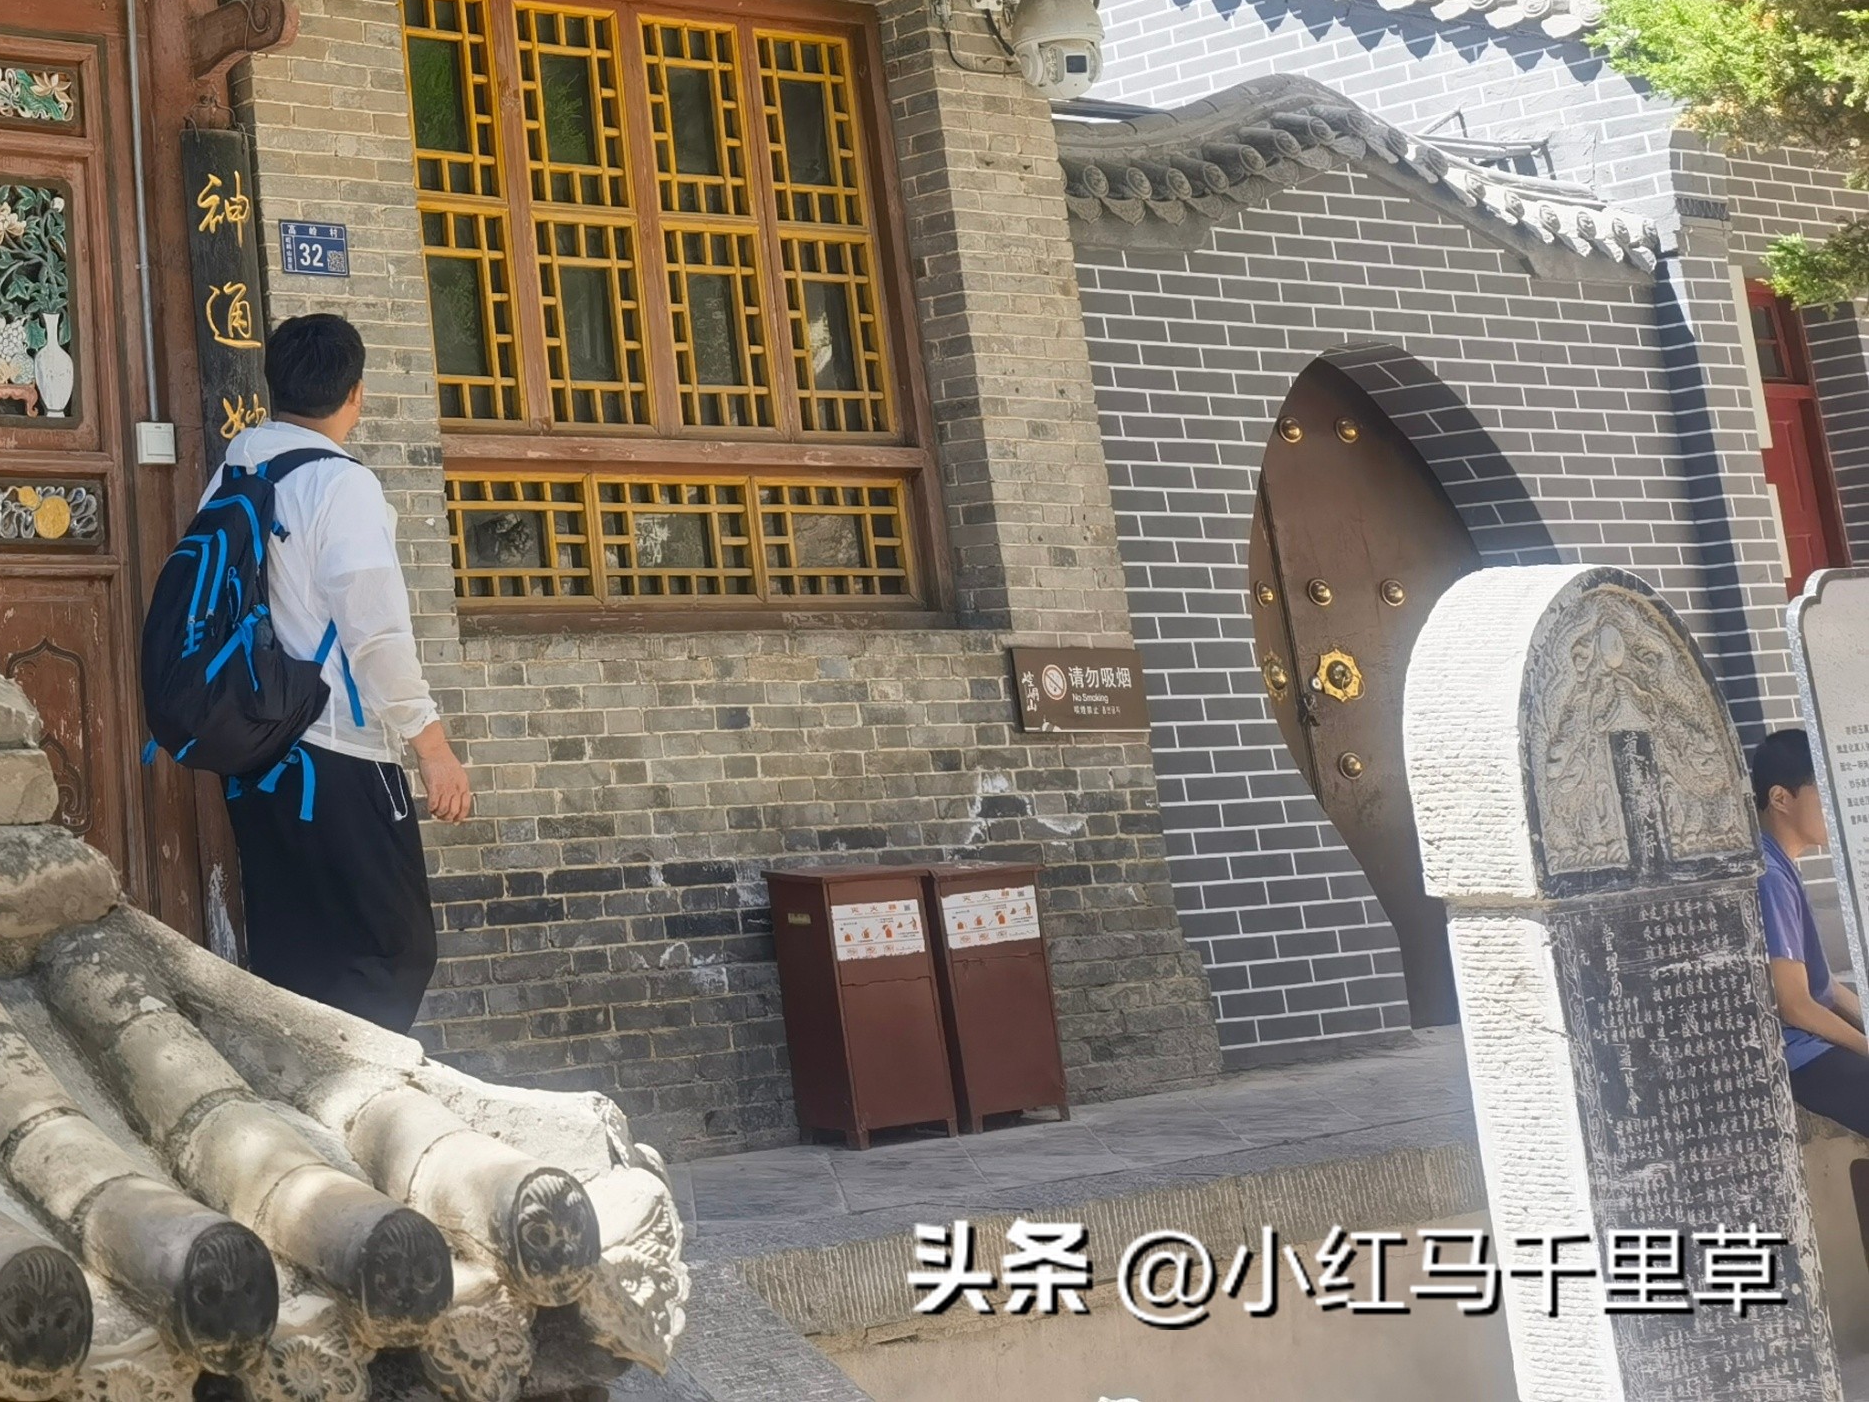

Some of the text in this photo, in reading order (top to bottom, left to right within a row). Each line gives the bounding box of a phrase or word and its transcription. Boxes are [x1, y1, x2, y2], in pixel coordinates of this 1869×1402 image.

[298, 242, 325, 267] 32
[1068, 666, 1132, 688] 请勿吸烟
[1072, 693, 1109, 704] No Smoking
